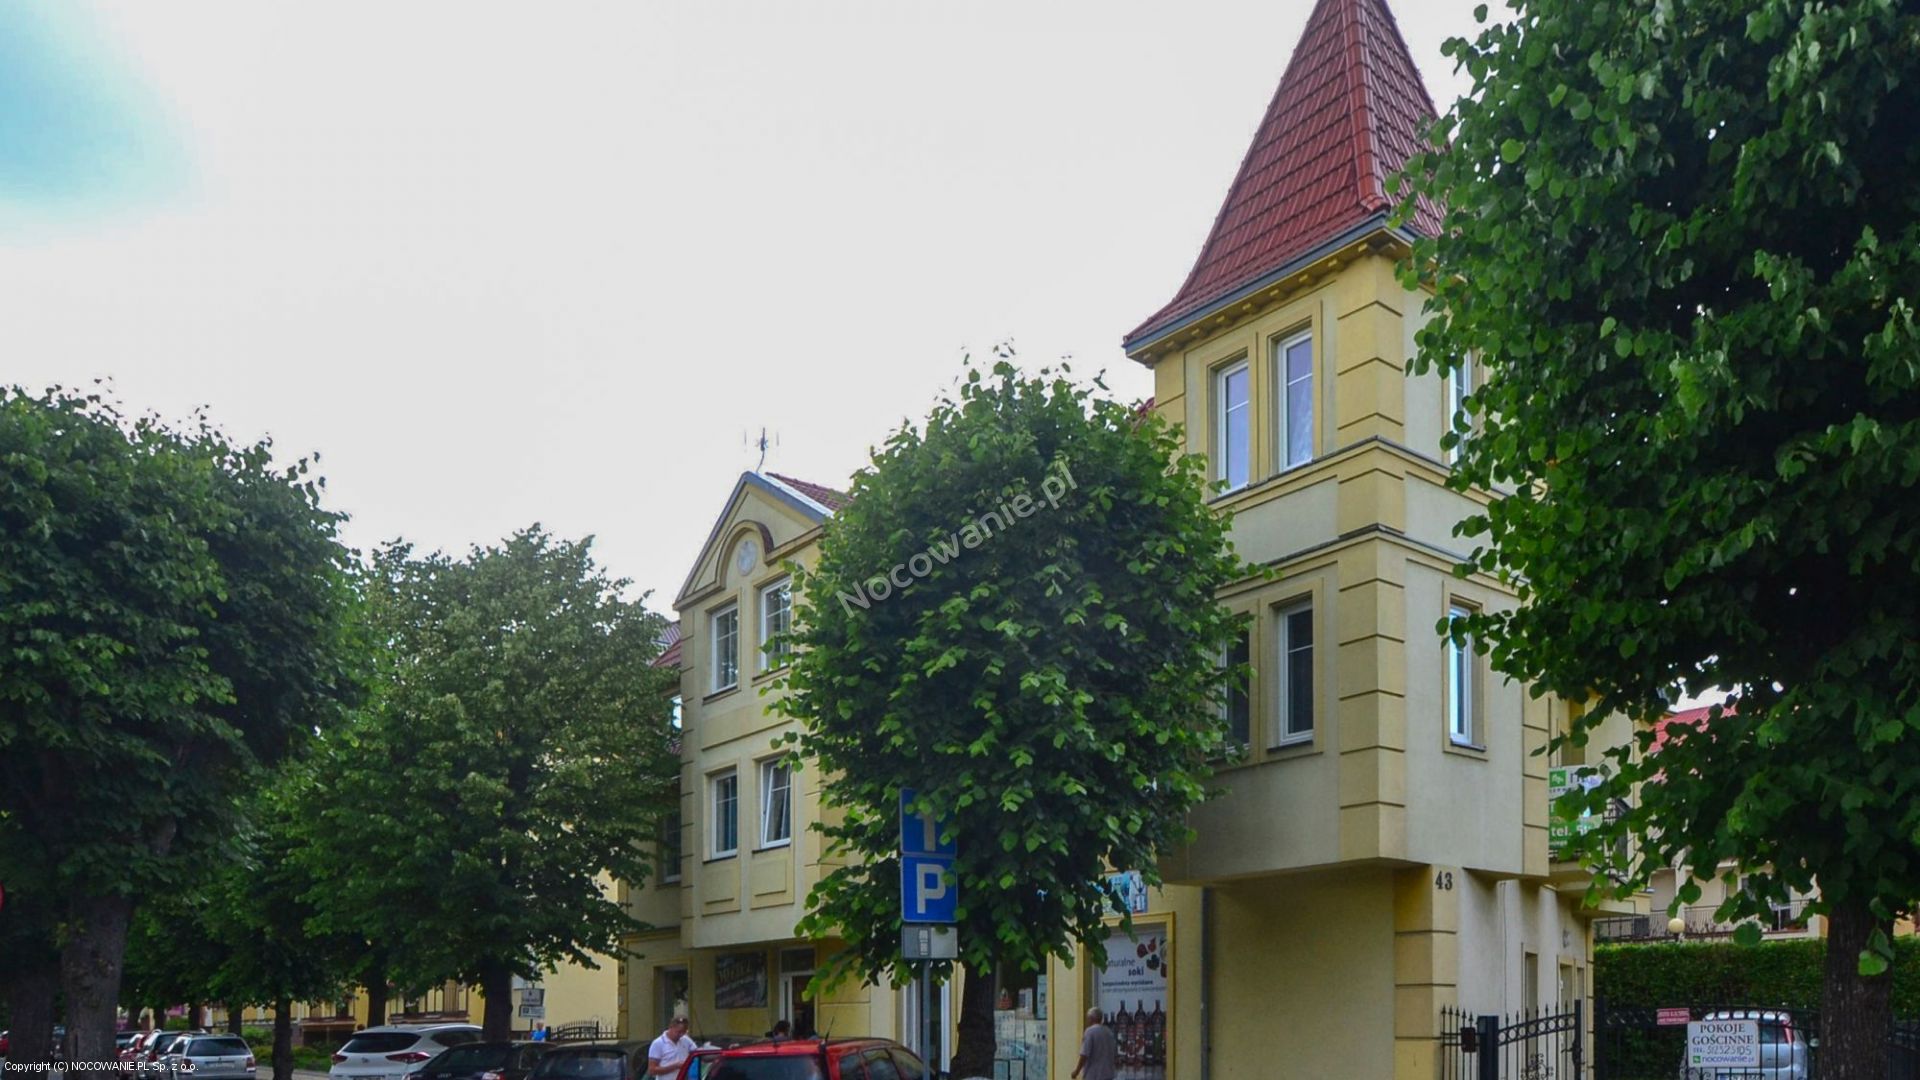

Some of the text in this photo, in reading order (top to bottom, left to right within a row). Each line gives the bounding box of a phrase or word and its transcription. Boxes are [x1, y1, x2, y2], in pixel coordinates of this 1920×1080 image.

[1551, 826, 1572, 837] tel.
[1435, 870, 1453, 891] 43
[916, 863, 946, 914] P
[1128, 966, 1144, 976] soki
[1700, 1023, 1745, 1034] POKOJE
[1692, 1034, 1754, 1046] GOŚCINNE
